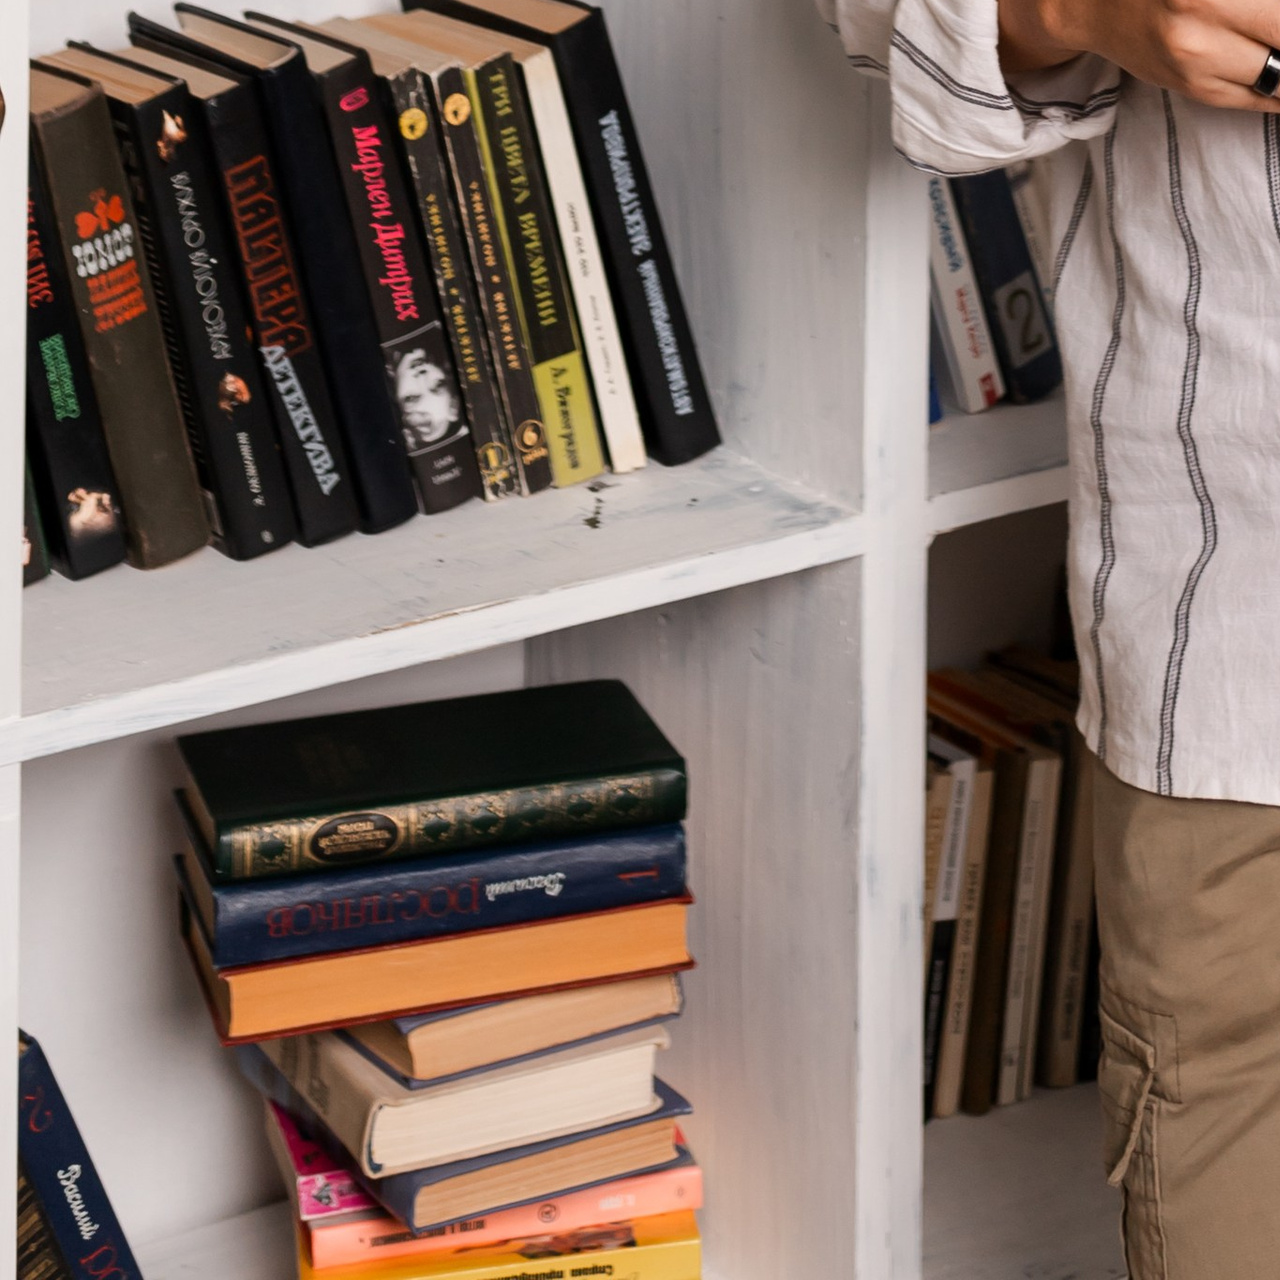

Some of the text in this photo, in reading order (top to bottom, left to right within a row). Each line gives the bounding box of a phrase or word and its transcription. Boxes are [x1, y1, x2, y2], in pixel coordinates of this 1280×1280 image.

[170, 170, 206, 248] ОРУЖИЯ
[351, 124, 419, 323] Марлен Дитрих
[599, 108, 653, 258] ЭЛЕКТРОПРИВОД
[517, 212, 559, 329] ВРЕМЕНИ
[1005, 287, 1044, 354] 2
[259, 345, 342, 497] ДЕТЕКТИВА
[265, 876, 481, 940] РОСЛЯКОВ
[56, 1163, 100, 1241] Василий
